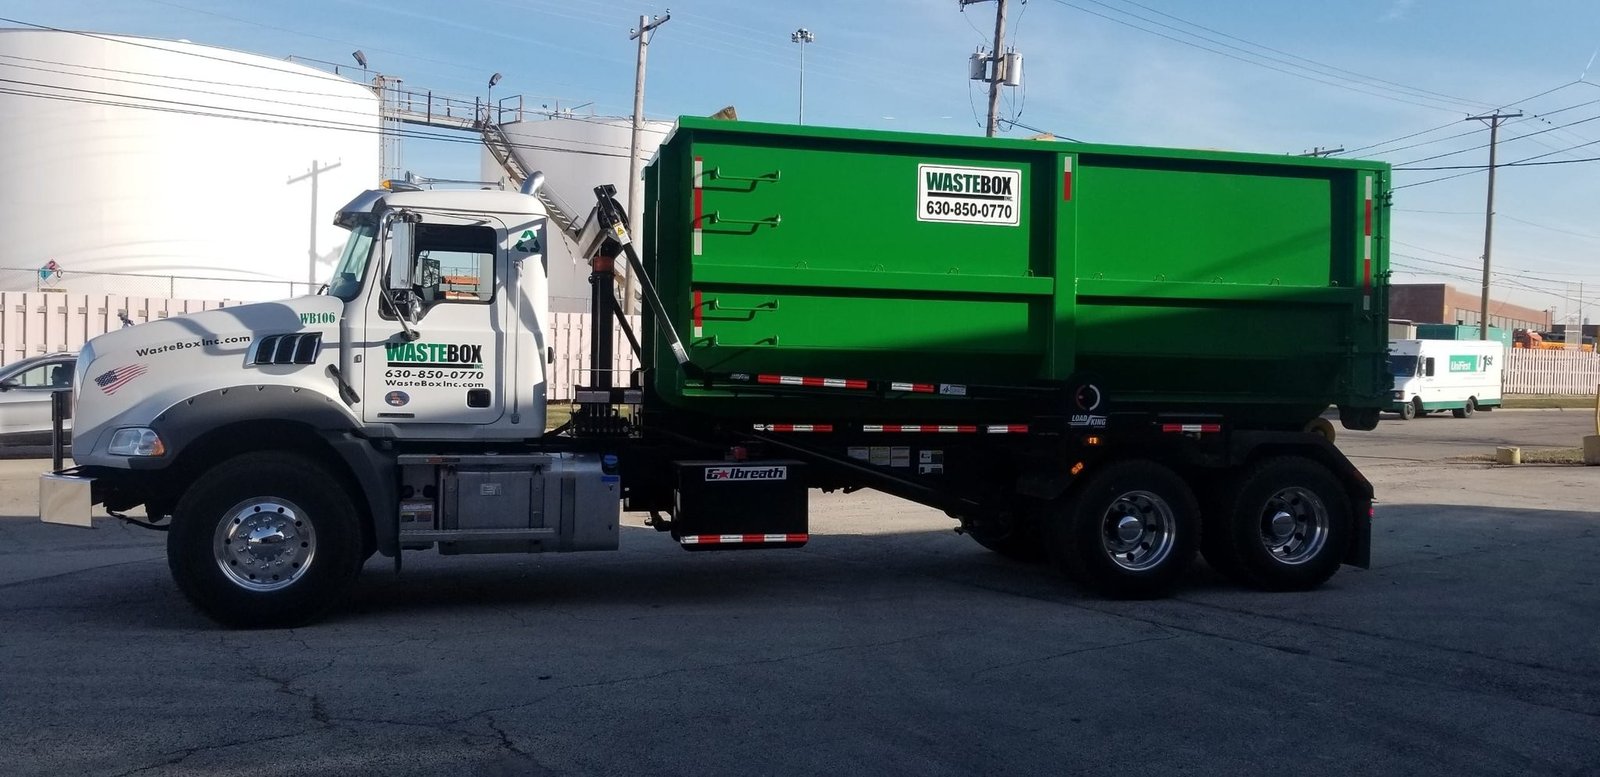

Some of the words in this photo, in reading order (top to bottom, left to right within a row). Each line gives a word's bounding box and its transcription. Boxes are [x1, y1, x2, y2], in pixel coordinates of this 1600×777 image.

[926, 172, 1012, 195] WASTEBOX
[49, 260, 56, 270] 2
[300, 312, 336, 324] WB106
[136, 335, 251, 357] WasteBoxInc.com
[385, 342, 483, 363] WASTEBOX
[385, 369, 484, 380] 630-850-0770
[385, 380, 484, 388] WasteBoxInc.com
[1071, 414, 1088, 422] LOAD
[1090, 418, 1107, 426] KING
